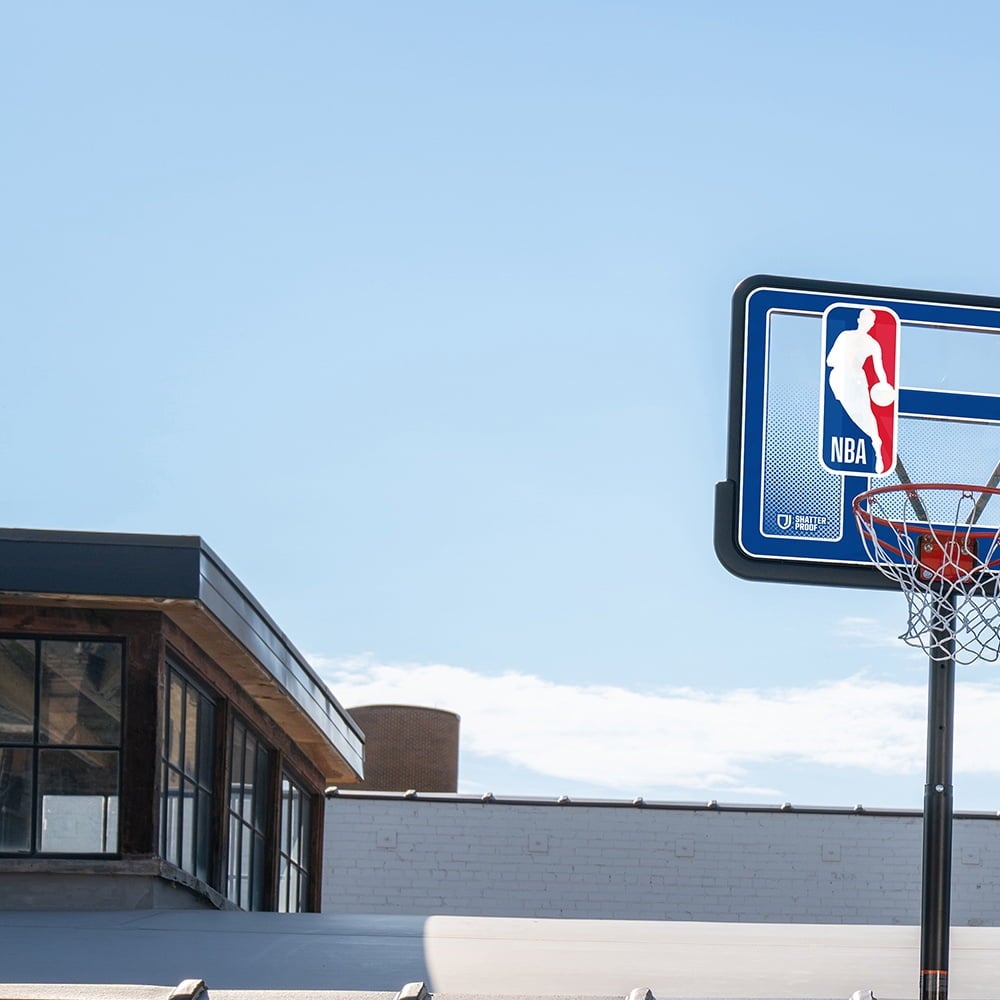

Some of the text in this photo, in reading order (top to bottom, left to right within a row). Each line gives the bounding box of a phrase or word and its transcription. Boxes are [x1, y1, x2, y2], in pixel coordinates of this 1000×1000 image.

[831, 436, 867, 465] NBA
[795, 515, 827, 524] SHATTER
[795, 523, 818, 531] PROOF
